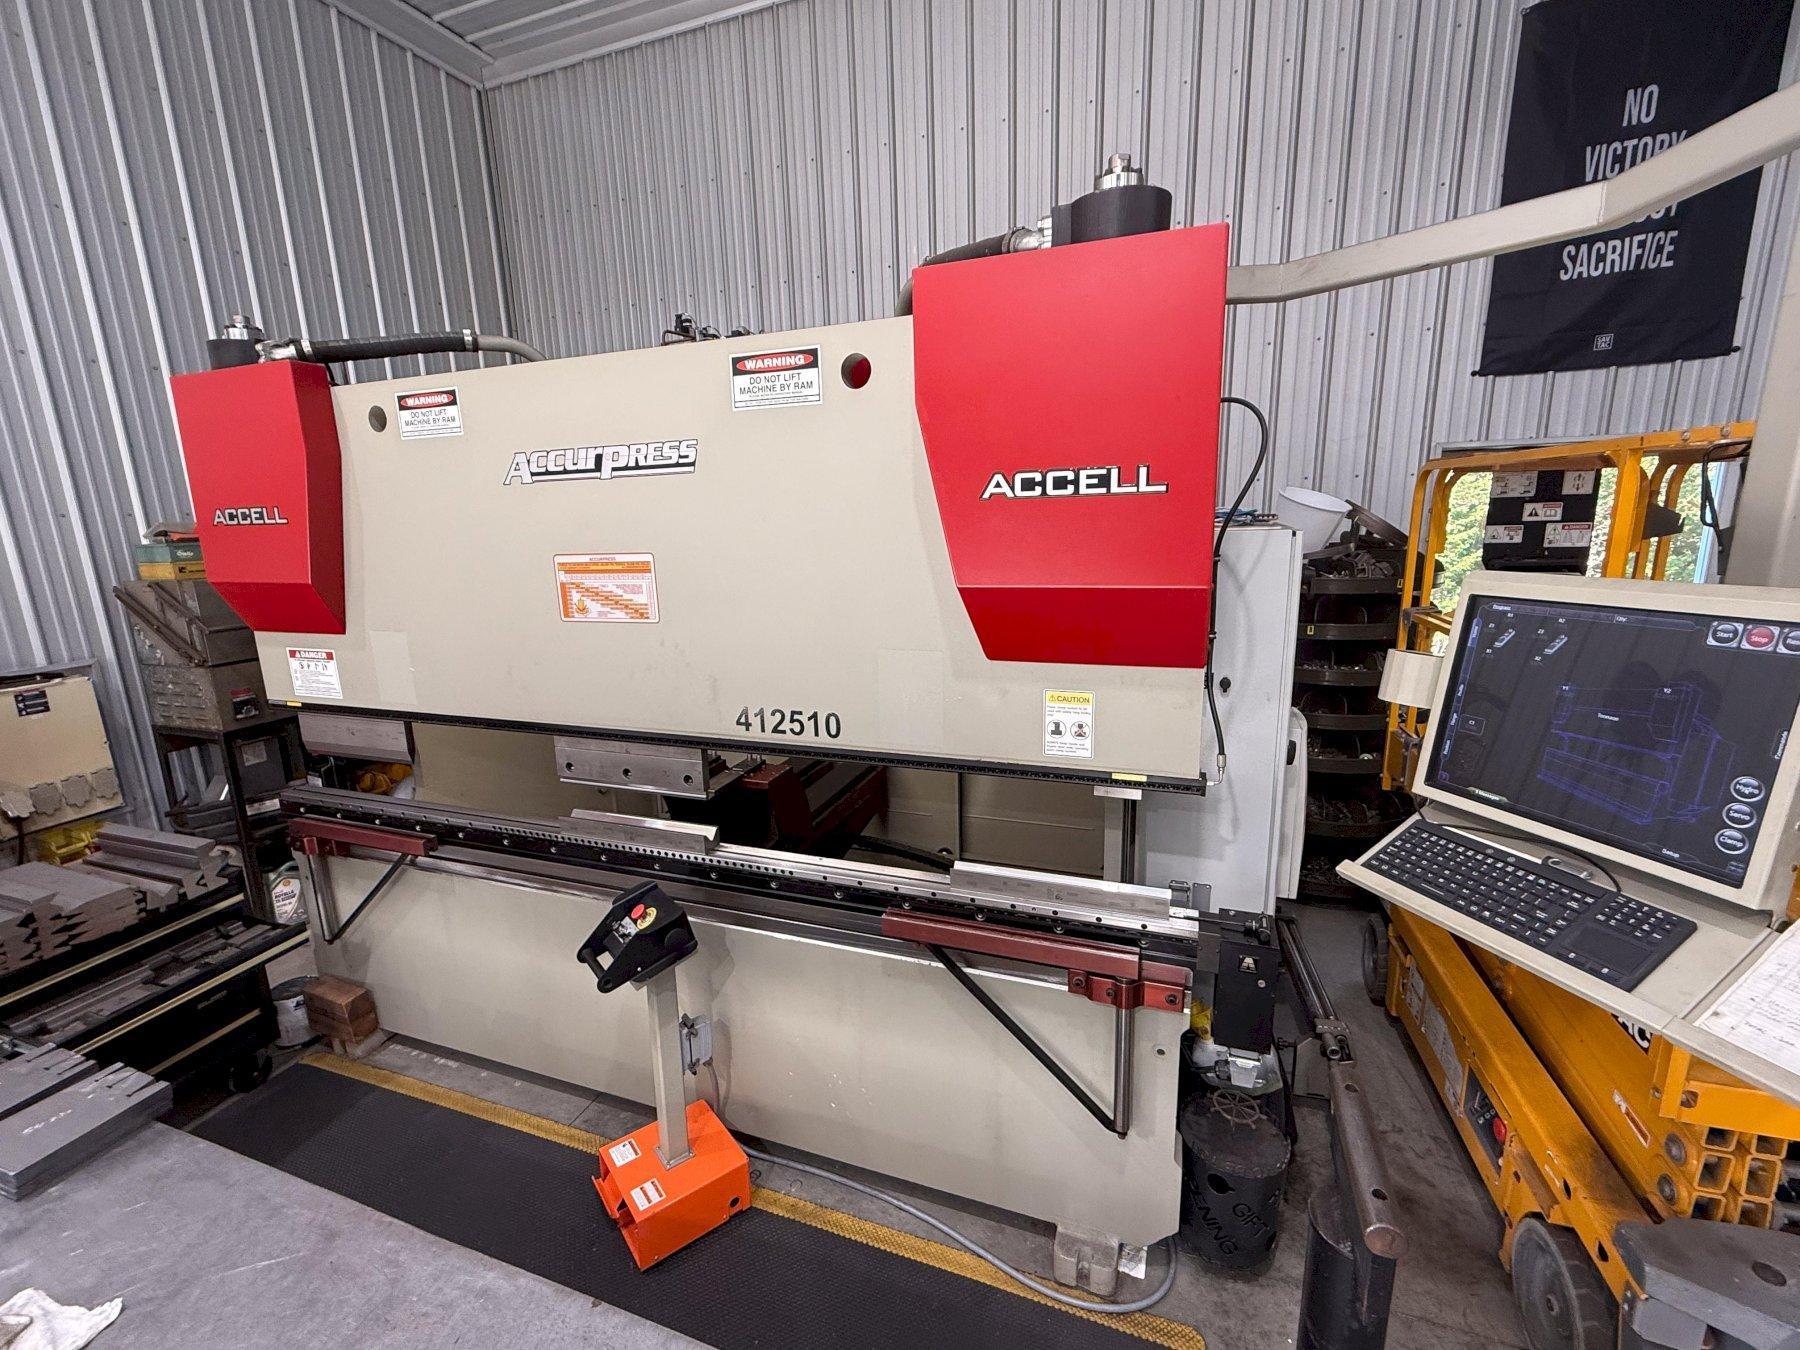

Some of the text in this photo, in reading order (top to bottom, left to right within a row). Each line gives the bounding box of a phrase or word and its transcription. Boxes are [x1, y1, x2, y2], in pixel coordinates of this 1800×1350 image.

[1622, 84, 1659, 127] NO
[1559, 230, 1678, 281] SACRIFICE
[744, 355, 805, 370] WARNING
[749, 372, 802, 385] DO NOT LIFT
[740, 384, 778, 395] MACHINE
[779, 383, 792, 391] BY
[793, 380, 814, 389] RAM
[405, 394, 448, 406] WARNING
[980, 464, 1169, 501] ACCELL
[213, 507, 288, 526] ACCELL
[1715, 630, 1734, 639] Start
[1750, 635, 1769, 644] Stop
[1056, 695, 1090, 704] CAUTION
[735, 705, 842, 739] 412510
[1728, 810, 1751, 821] Servo
[1719, 835, 1744, 848] Clamp
